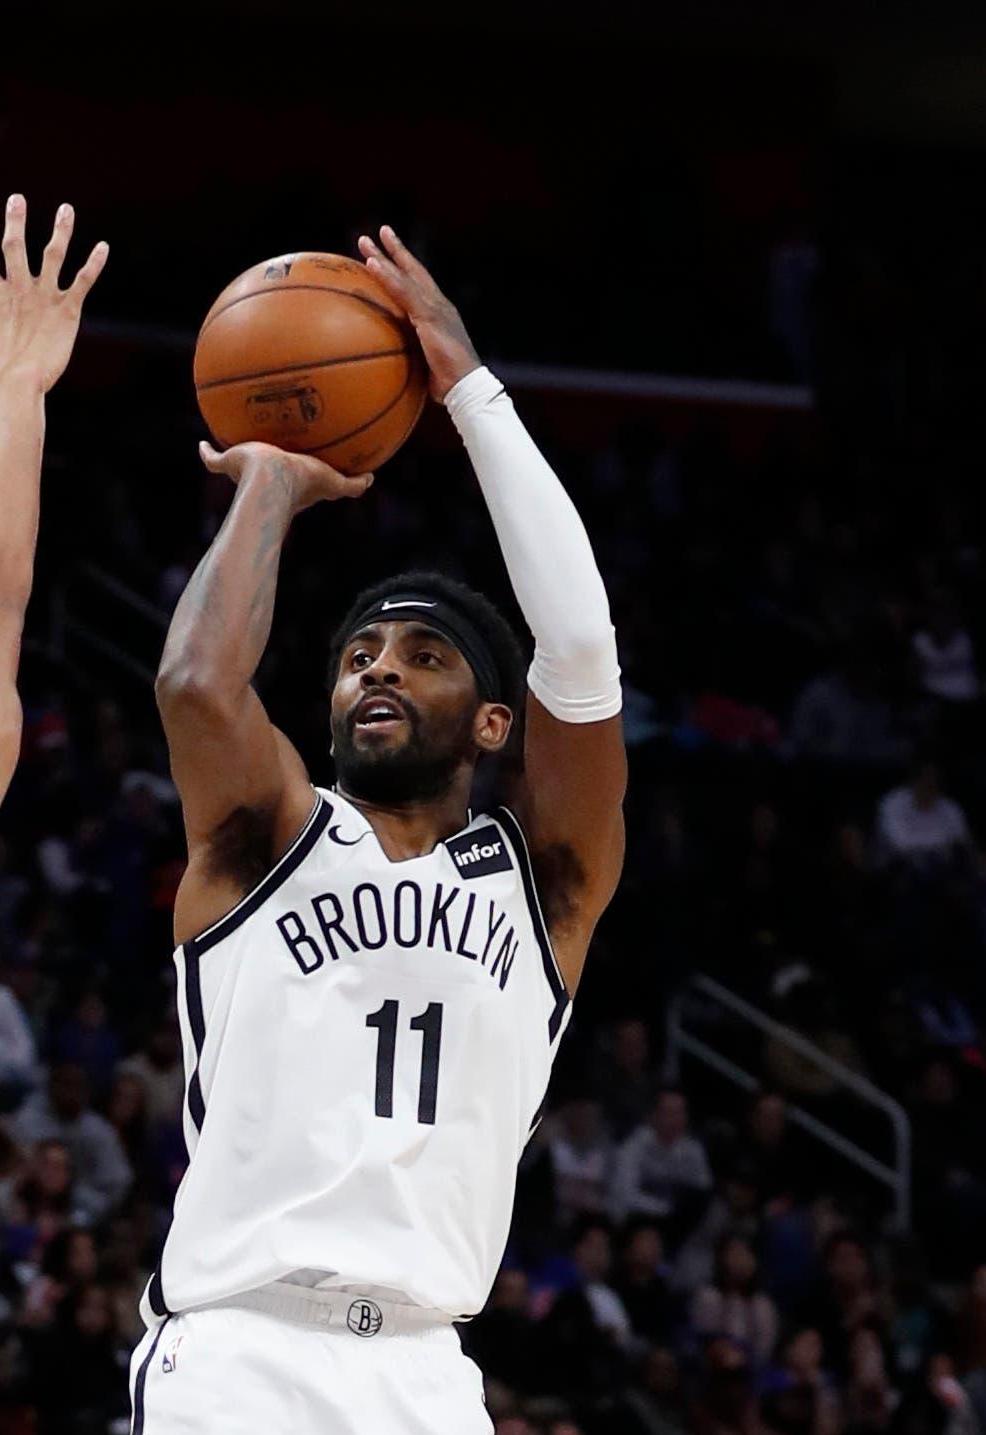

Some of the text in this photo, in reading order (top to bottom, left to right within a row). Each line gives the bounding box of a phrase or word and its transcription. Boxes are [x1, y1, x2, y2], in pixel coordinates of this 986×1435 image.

[454, 842, 502, 867] infor
[276, 880, 519, 992] BROOKLYN
[365, 999, 444, 1125] 11
